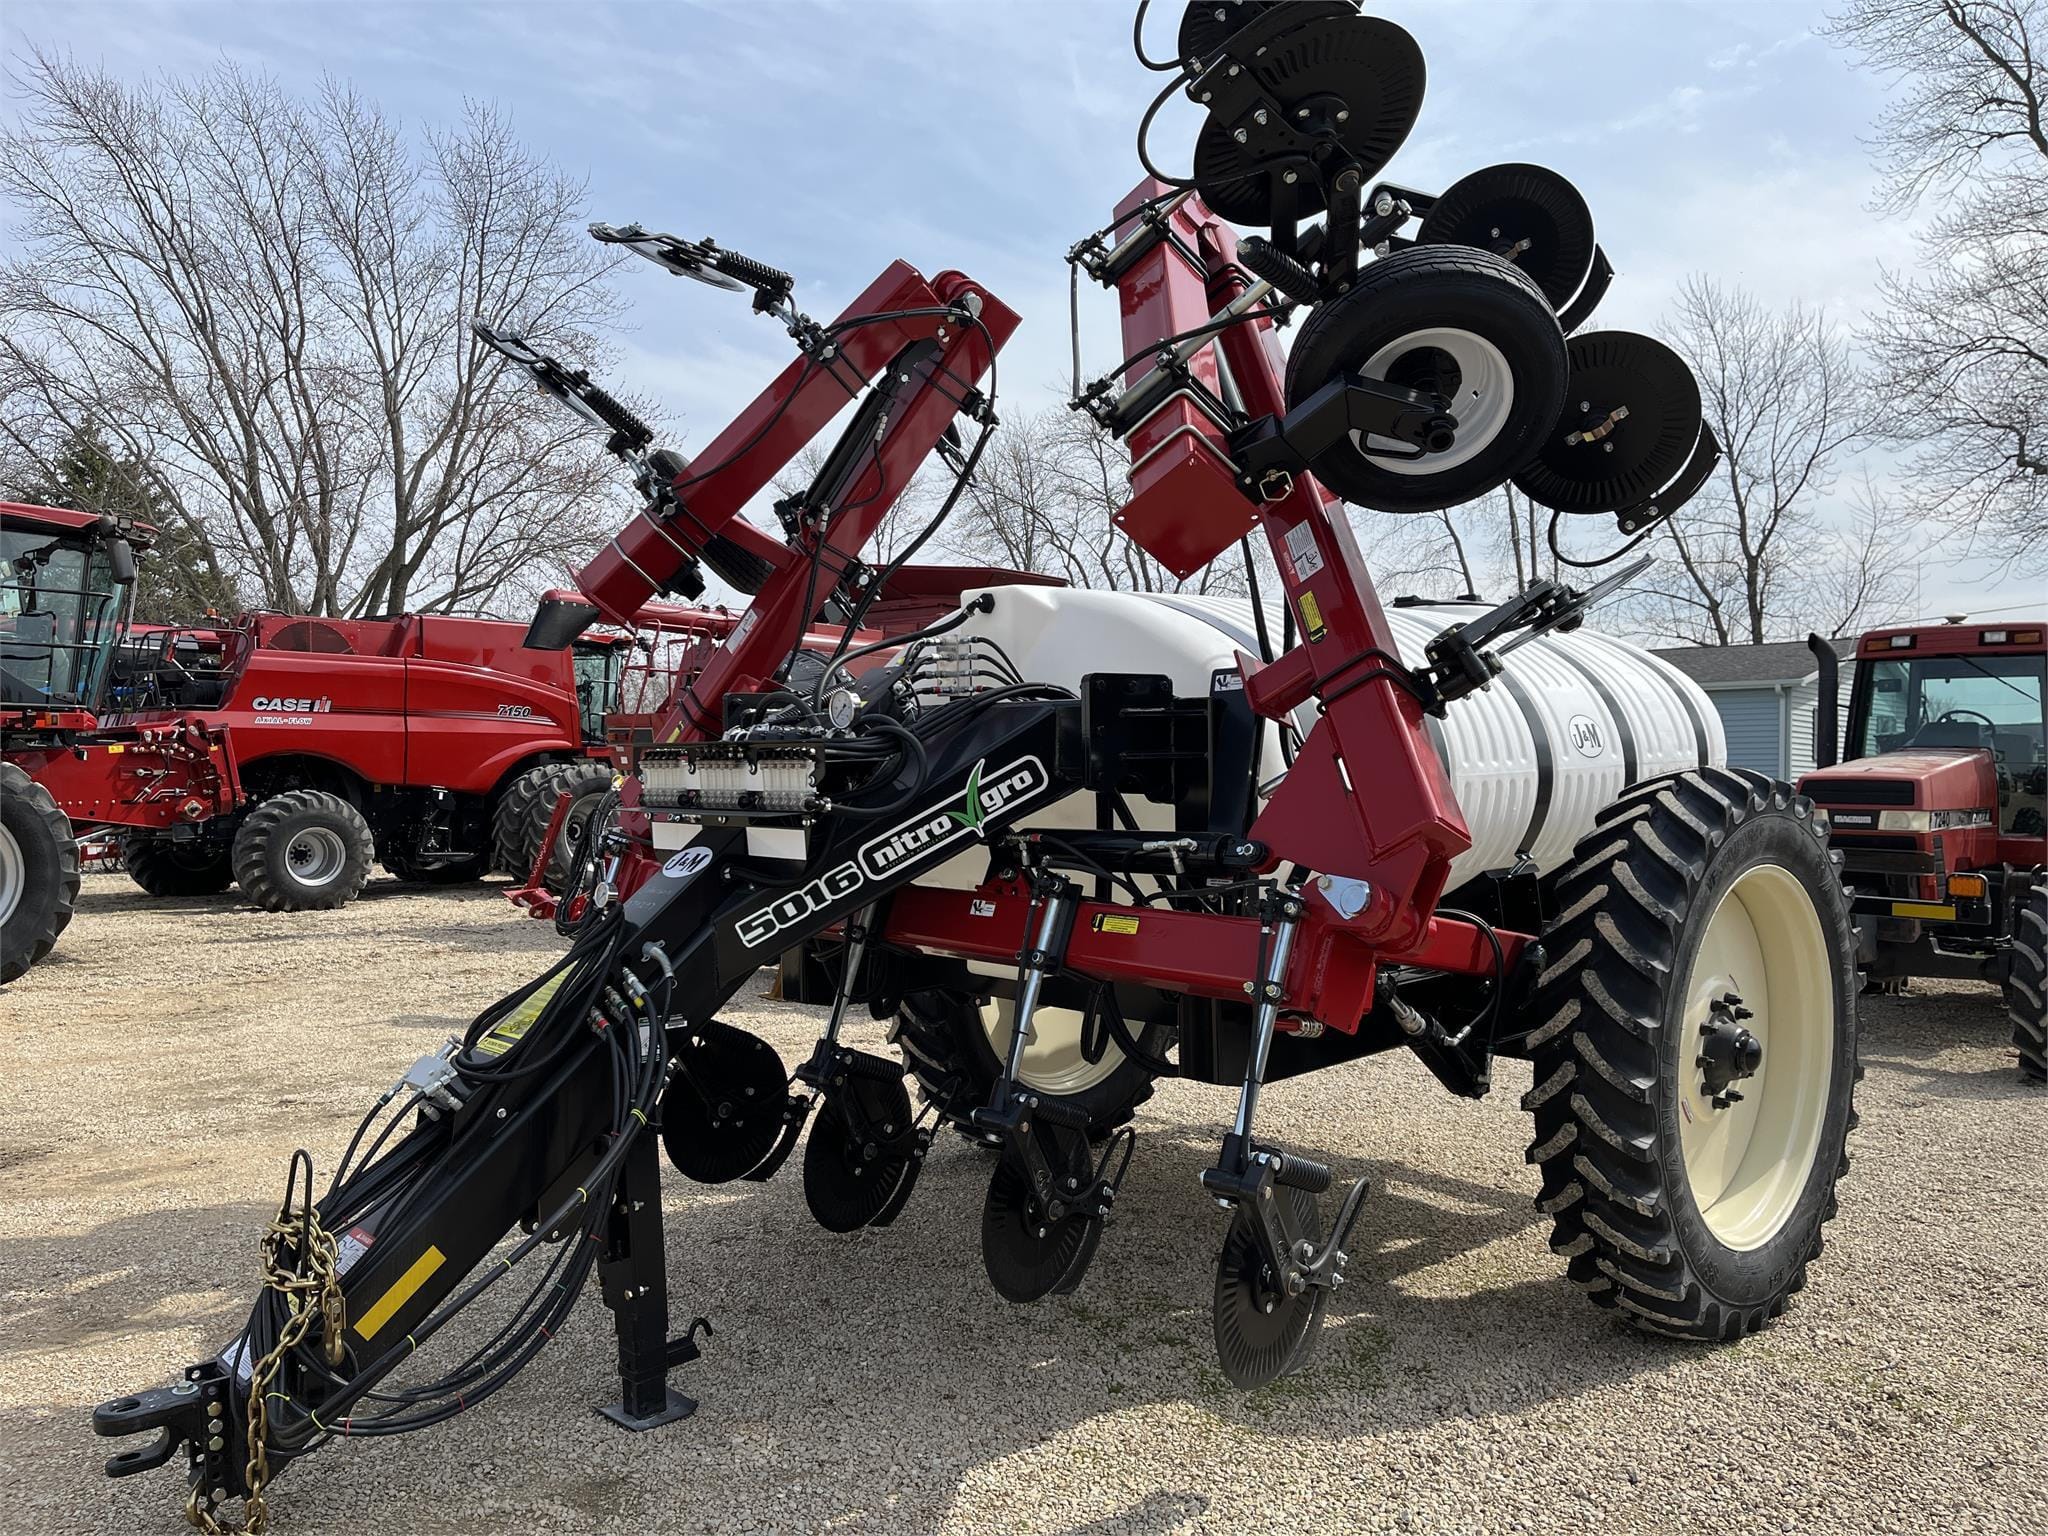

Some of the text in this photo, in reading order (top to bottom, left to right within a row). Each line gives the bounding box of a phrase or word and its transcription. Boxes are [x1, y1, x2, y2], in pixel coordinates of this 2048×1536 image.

[252, 696, 311, 712] CASE
[497, 704, 532, 718] 7150
[254, 716, 313, 725] AXIAL-FLOW
[1572, 723, 1602, 749] J&M
[872, 769, 1034, 868] nitro gro
[664, 852, 710, 873] J&M
[884, 851, 915, 869] PRECISION
[735, 861, 865, 948] 5016
